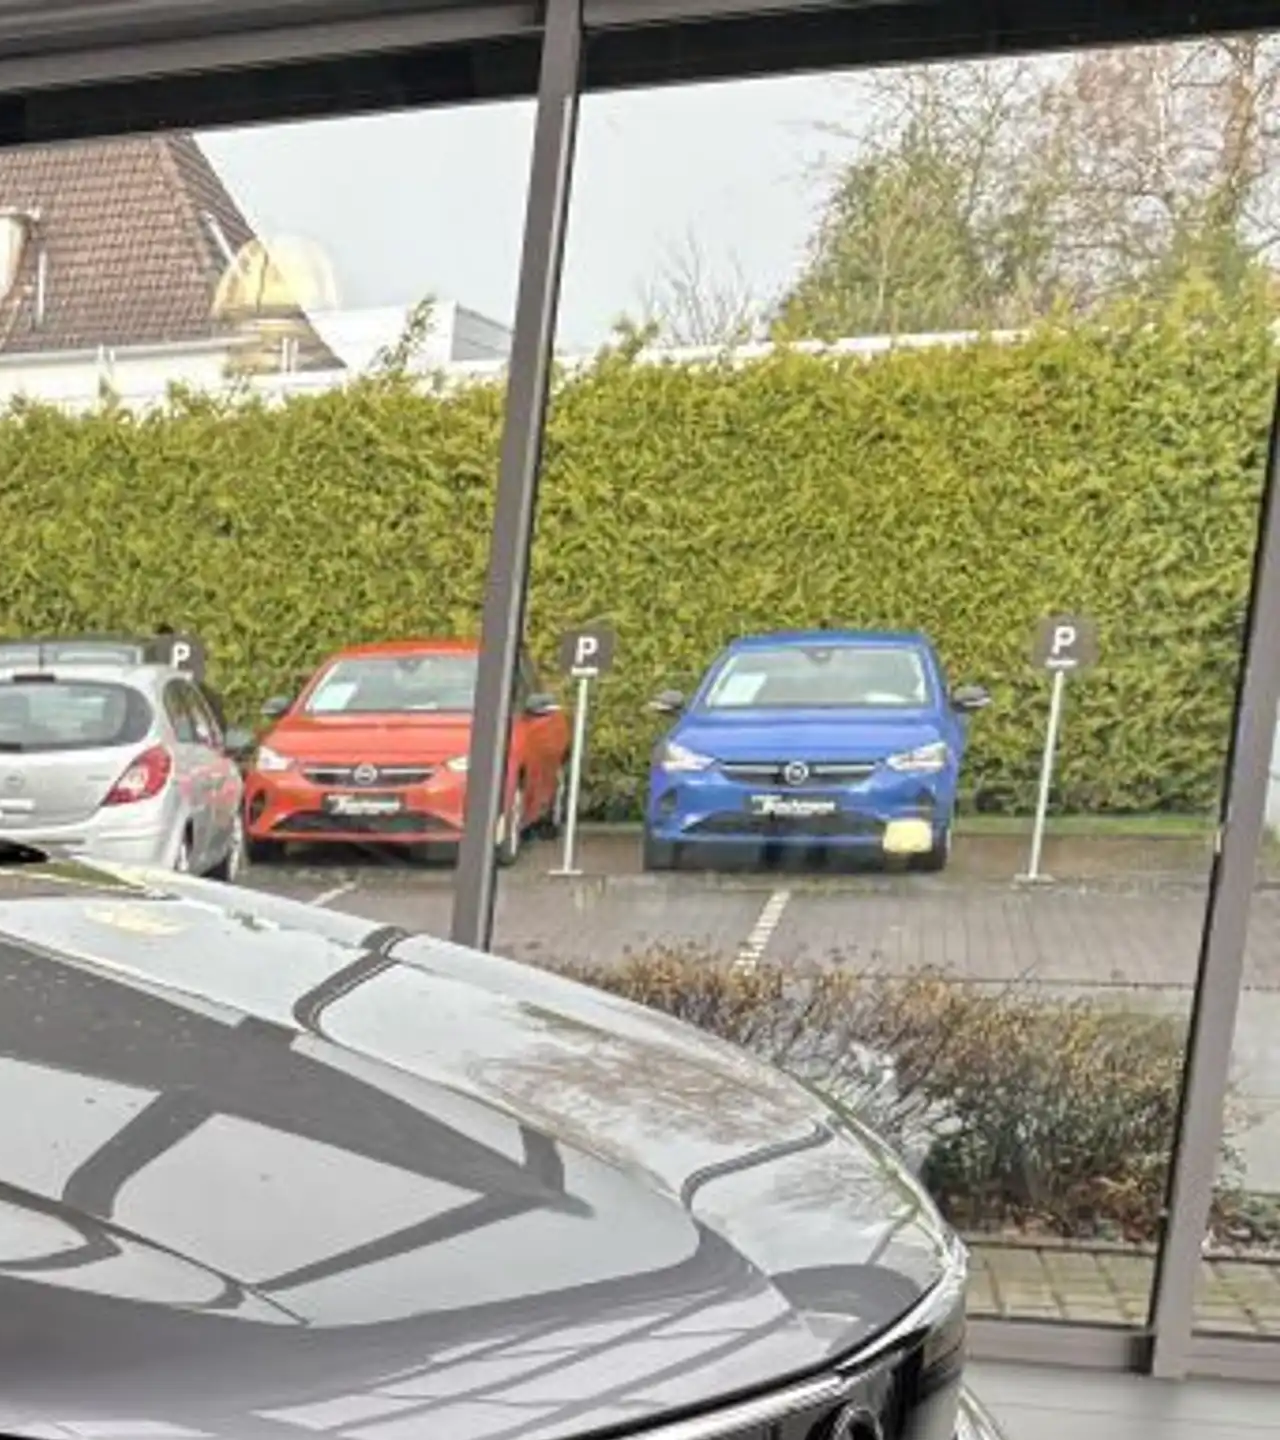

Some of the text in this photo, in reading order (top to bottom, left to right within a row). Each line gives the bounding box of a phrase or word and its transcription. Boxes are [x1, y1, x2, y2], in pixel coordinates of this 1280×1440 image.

[575, 636, 599, 664] P
[1052, 625, 1076, 655] P
[171, 641, 191, 668] P
